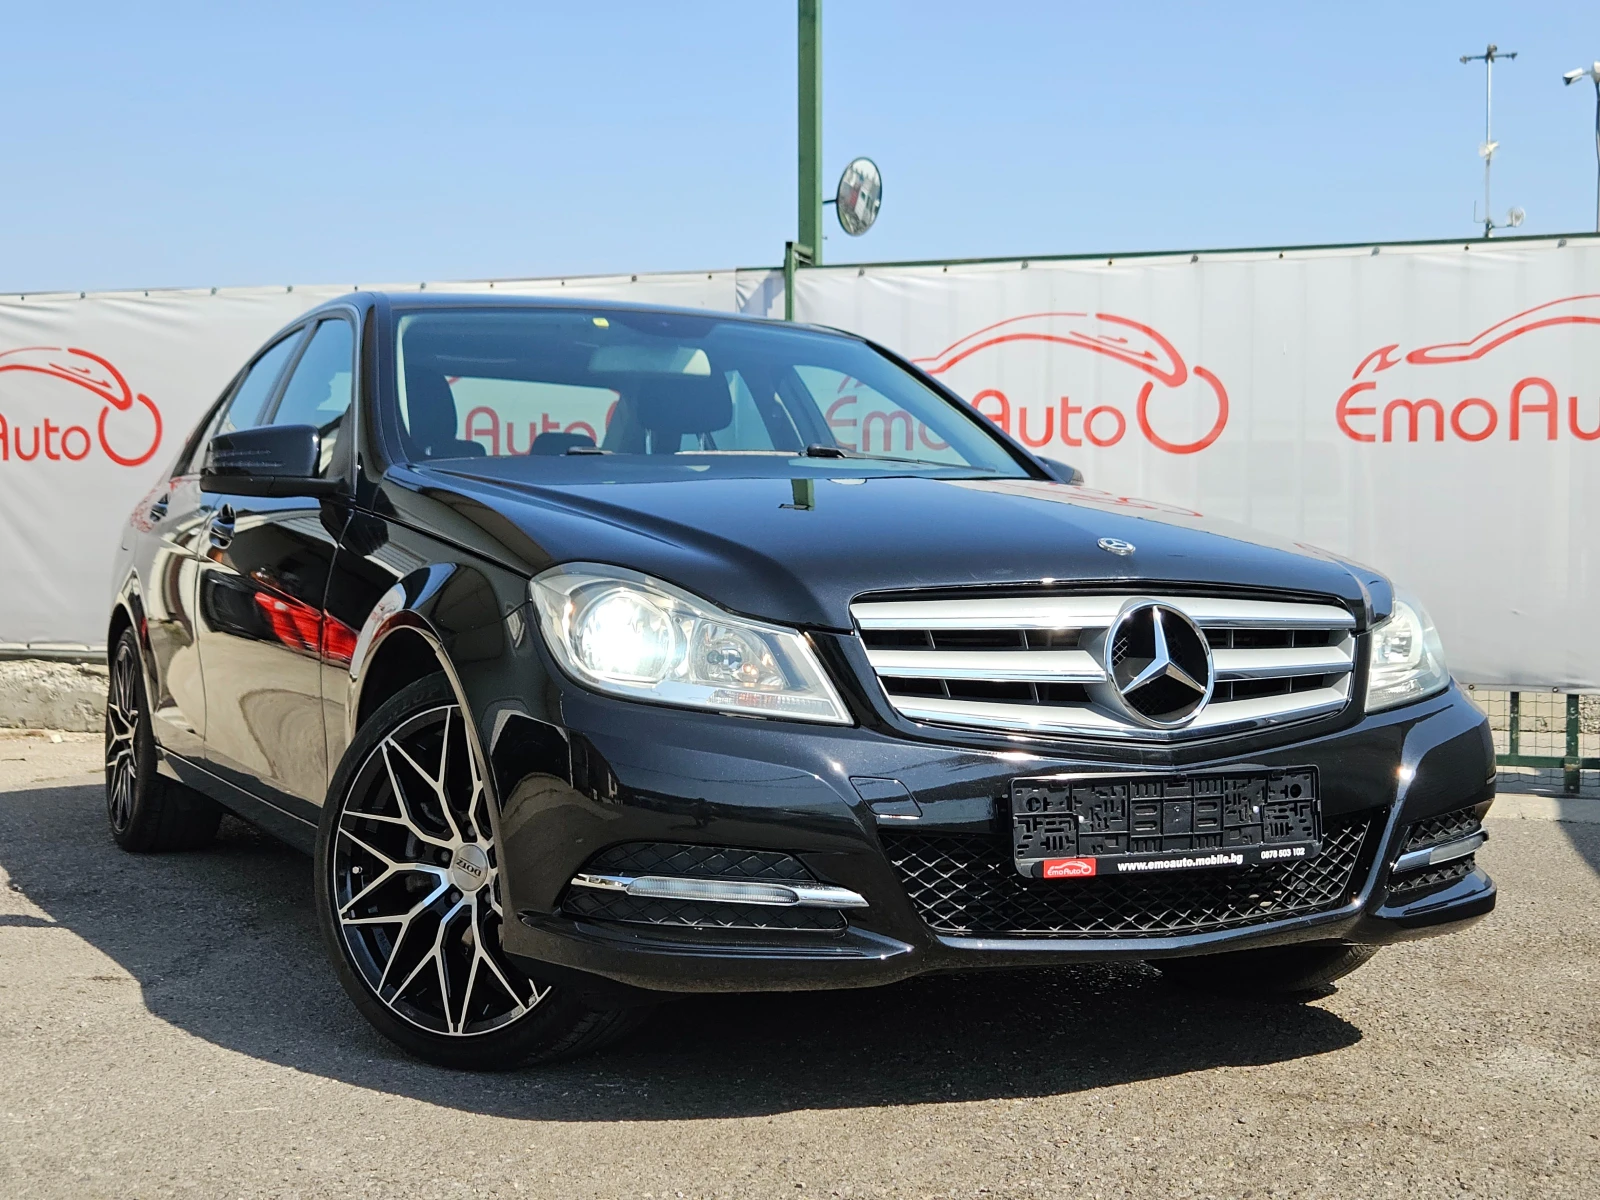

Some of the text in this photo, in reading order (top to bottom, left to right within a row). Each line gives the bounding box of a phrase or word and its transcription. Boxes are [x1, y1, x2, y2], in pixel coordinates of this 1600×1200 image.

[0, 412, 91, 461] uto
[1117, 853, 1244, 871] www.emoauto.mobile.bg
[1260, 847, 1306, 859] 0878 503 102
[456, 859, 482, 877] DOTZ
